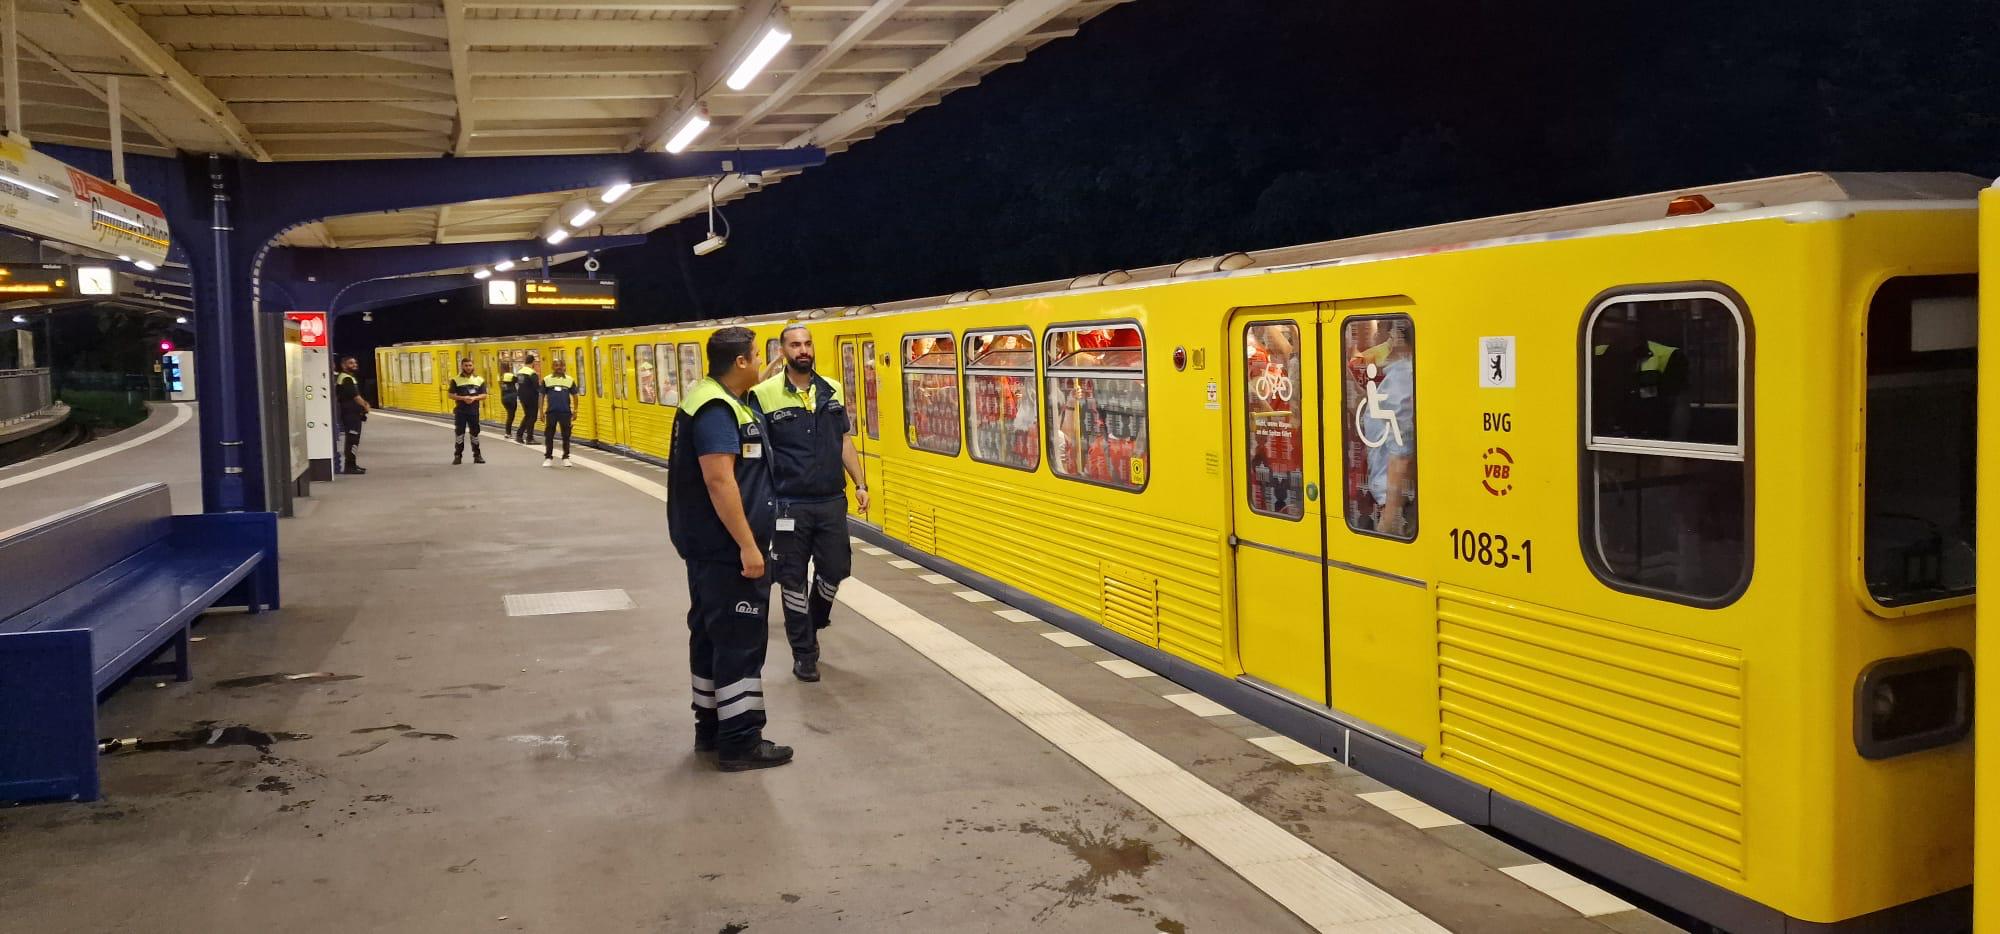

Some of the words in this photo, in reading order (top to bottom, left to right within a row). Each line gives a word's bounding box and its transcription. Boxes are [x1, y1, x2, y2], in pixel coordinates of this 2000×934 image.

[1483, 412, 1512, 432] BVG
[1484, 464, 1510, 479] VBB
[1449, 528, 1533, 574] 1083-1
